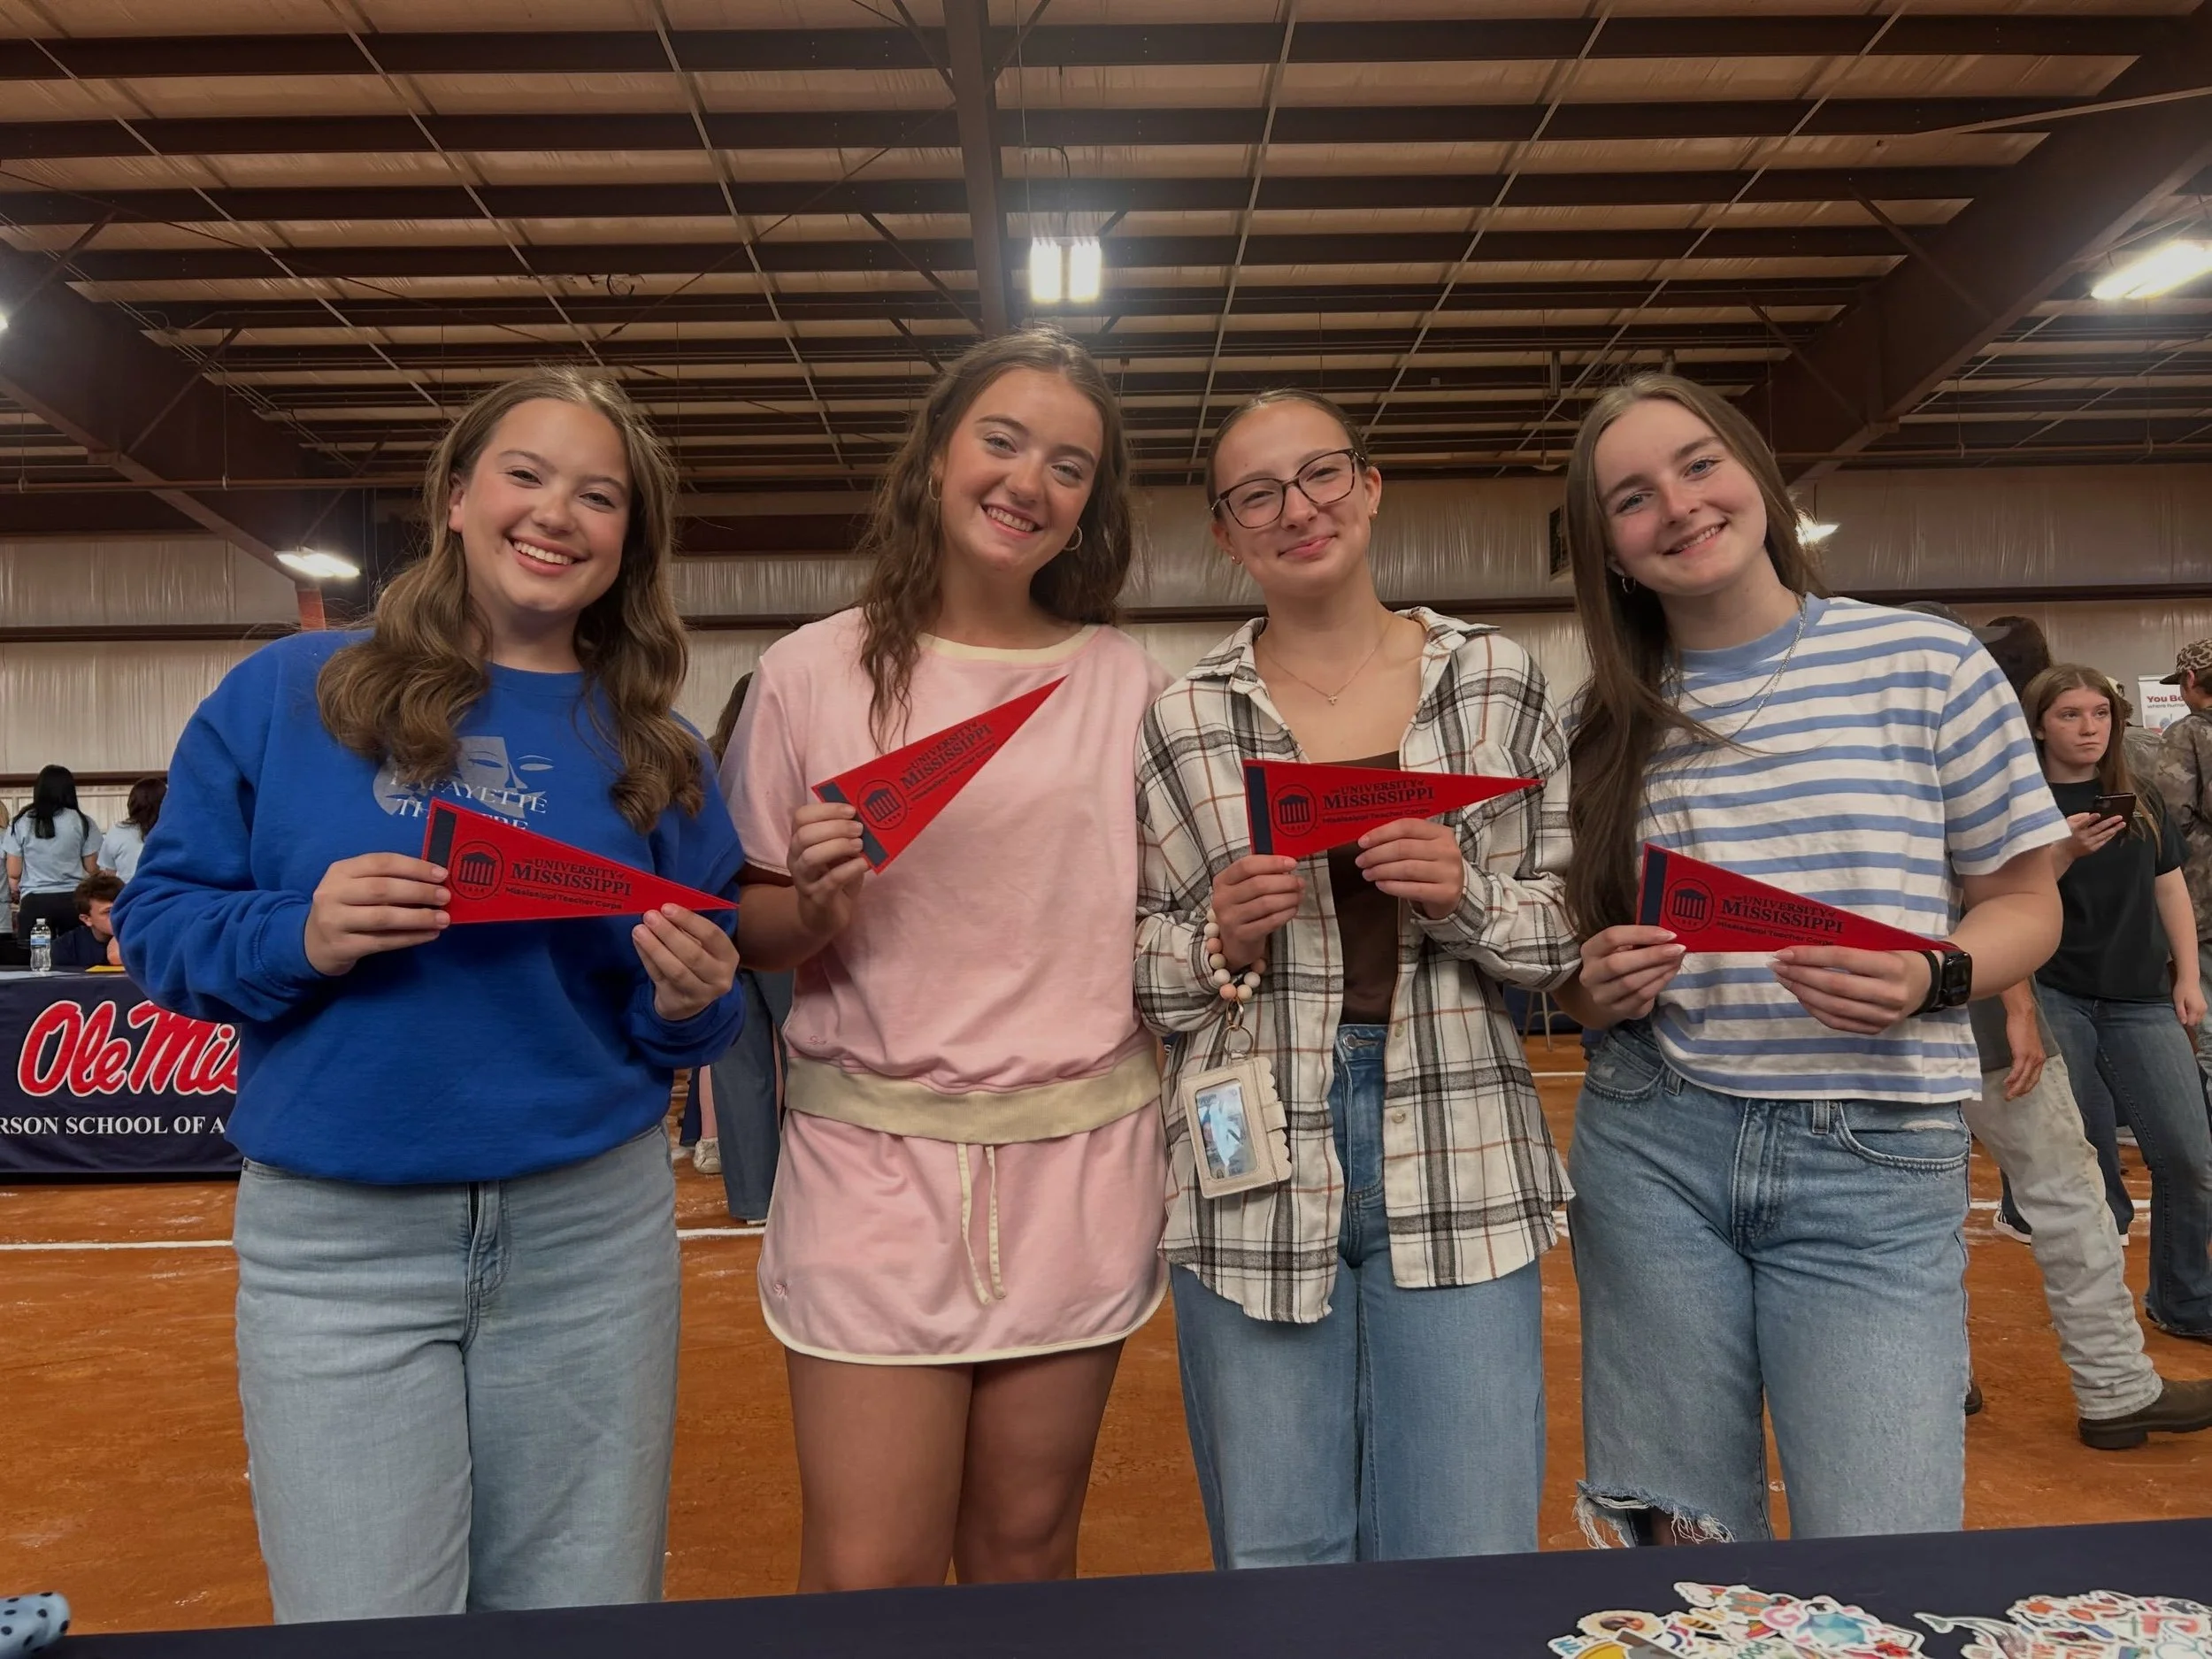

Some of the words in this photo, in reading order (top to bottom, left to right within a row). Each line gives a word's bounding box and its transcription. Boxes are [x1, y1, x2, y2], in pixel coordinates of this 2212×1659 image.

[900, 724, 992, 789] MISSISSIPPI
[910, 722, 973, 769] UNIVERSITY
[1323, 787, 1434, 810] MISSISSIPPI
[1340, 779, 1417, 795] UNIVERSITY
[511, 863, 631, 896] MISSISSIPPI
[534, 858, 617, 879] UNIVERSITY
[1721, 899, 1844, 934] MISSISSIPPI
[1743, 895, 1826, 918] UNIVERSITY
[18, 1000, 131, 1097] Ole
[65, 1116, 167, 1135] SCHOOL
[173, 1116, 206, 1135] OF
